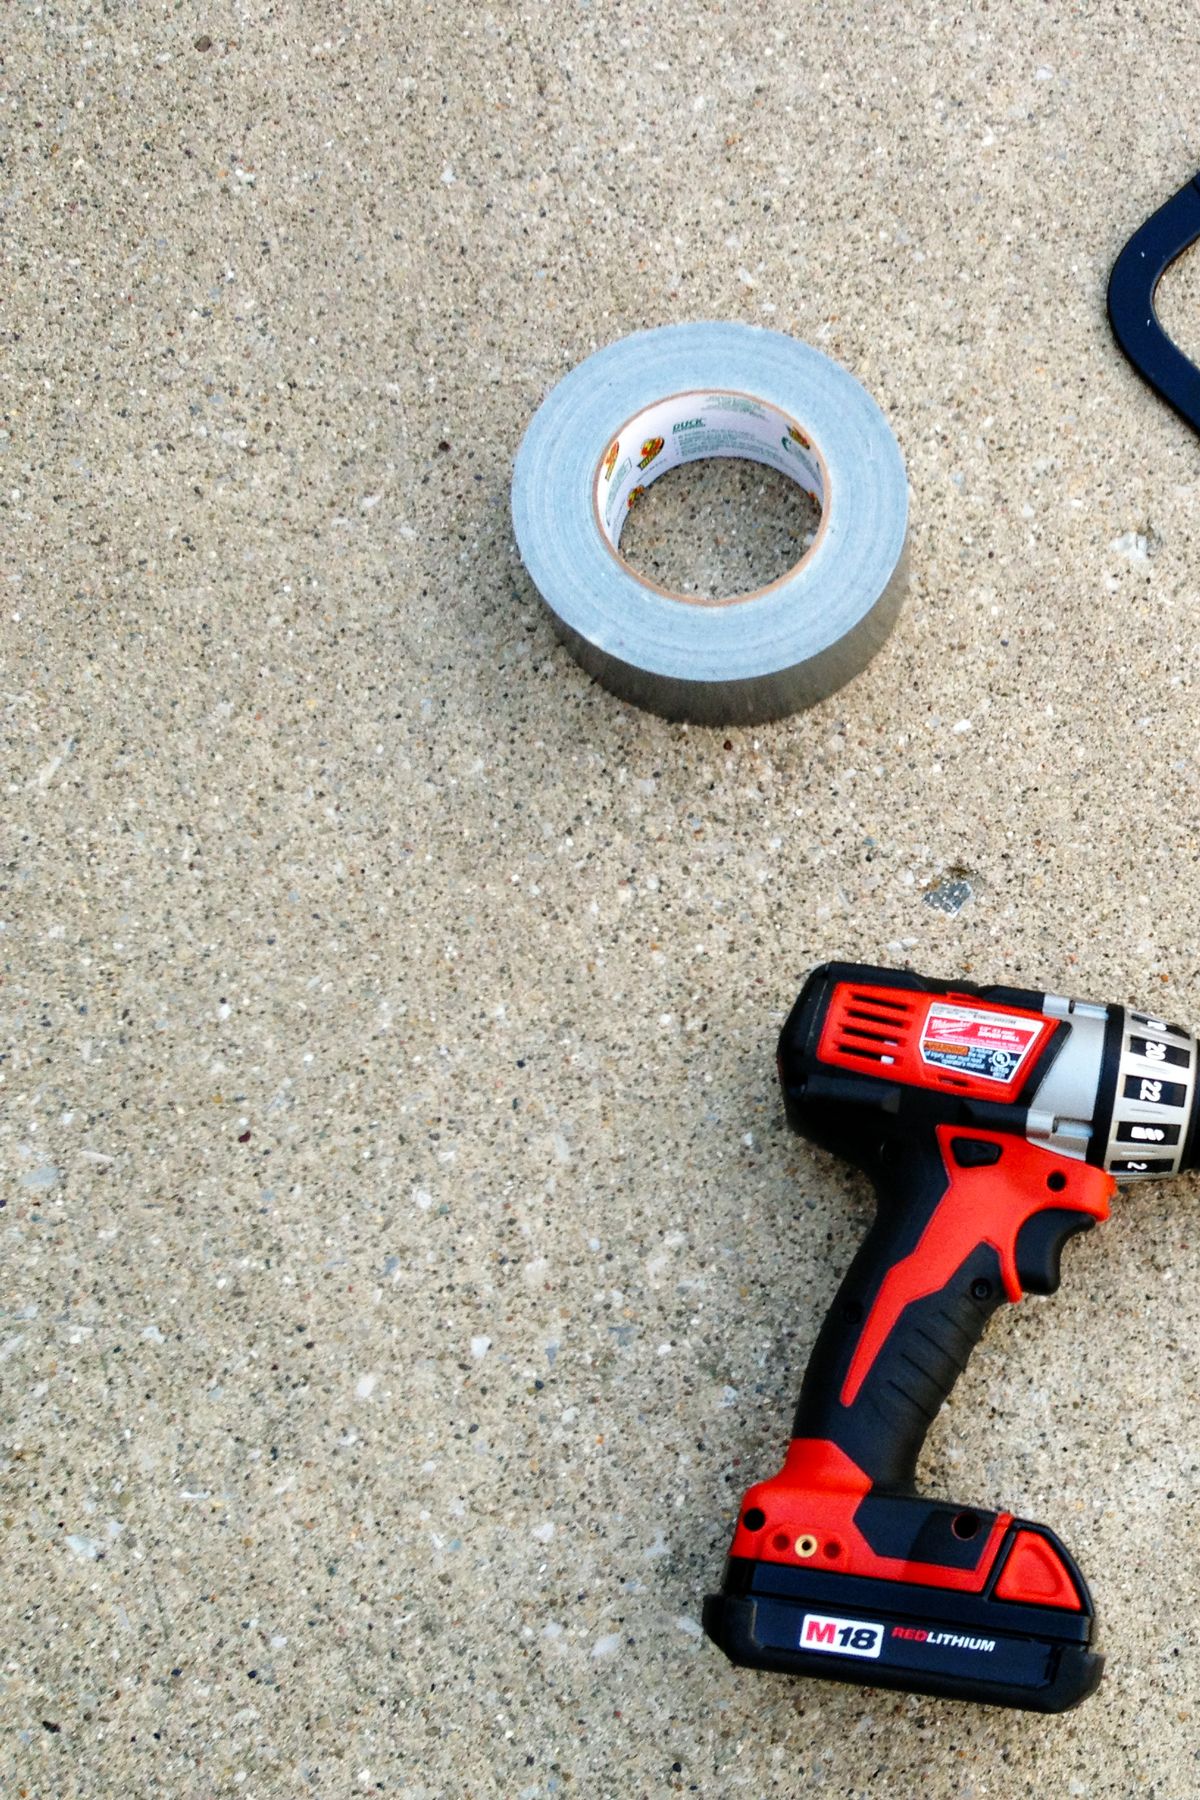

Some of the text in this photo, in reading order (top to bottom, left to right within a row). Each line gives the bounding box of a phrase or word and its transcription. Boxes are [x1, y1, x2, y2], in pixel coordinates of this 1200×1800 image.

[930, 1019, 973, 1031] Milwaukee
[1145, 1041, 1167, 1061] 20
[1139, 1079, 1163, 1102] 22
[1127, 1161, 1148, 1170] 2
[805, 1621, 879, 1651] M18
[892, 1627, 996, 1652] REDLITHIUM
